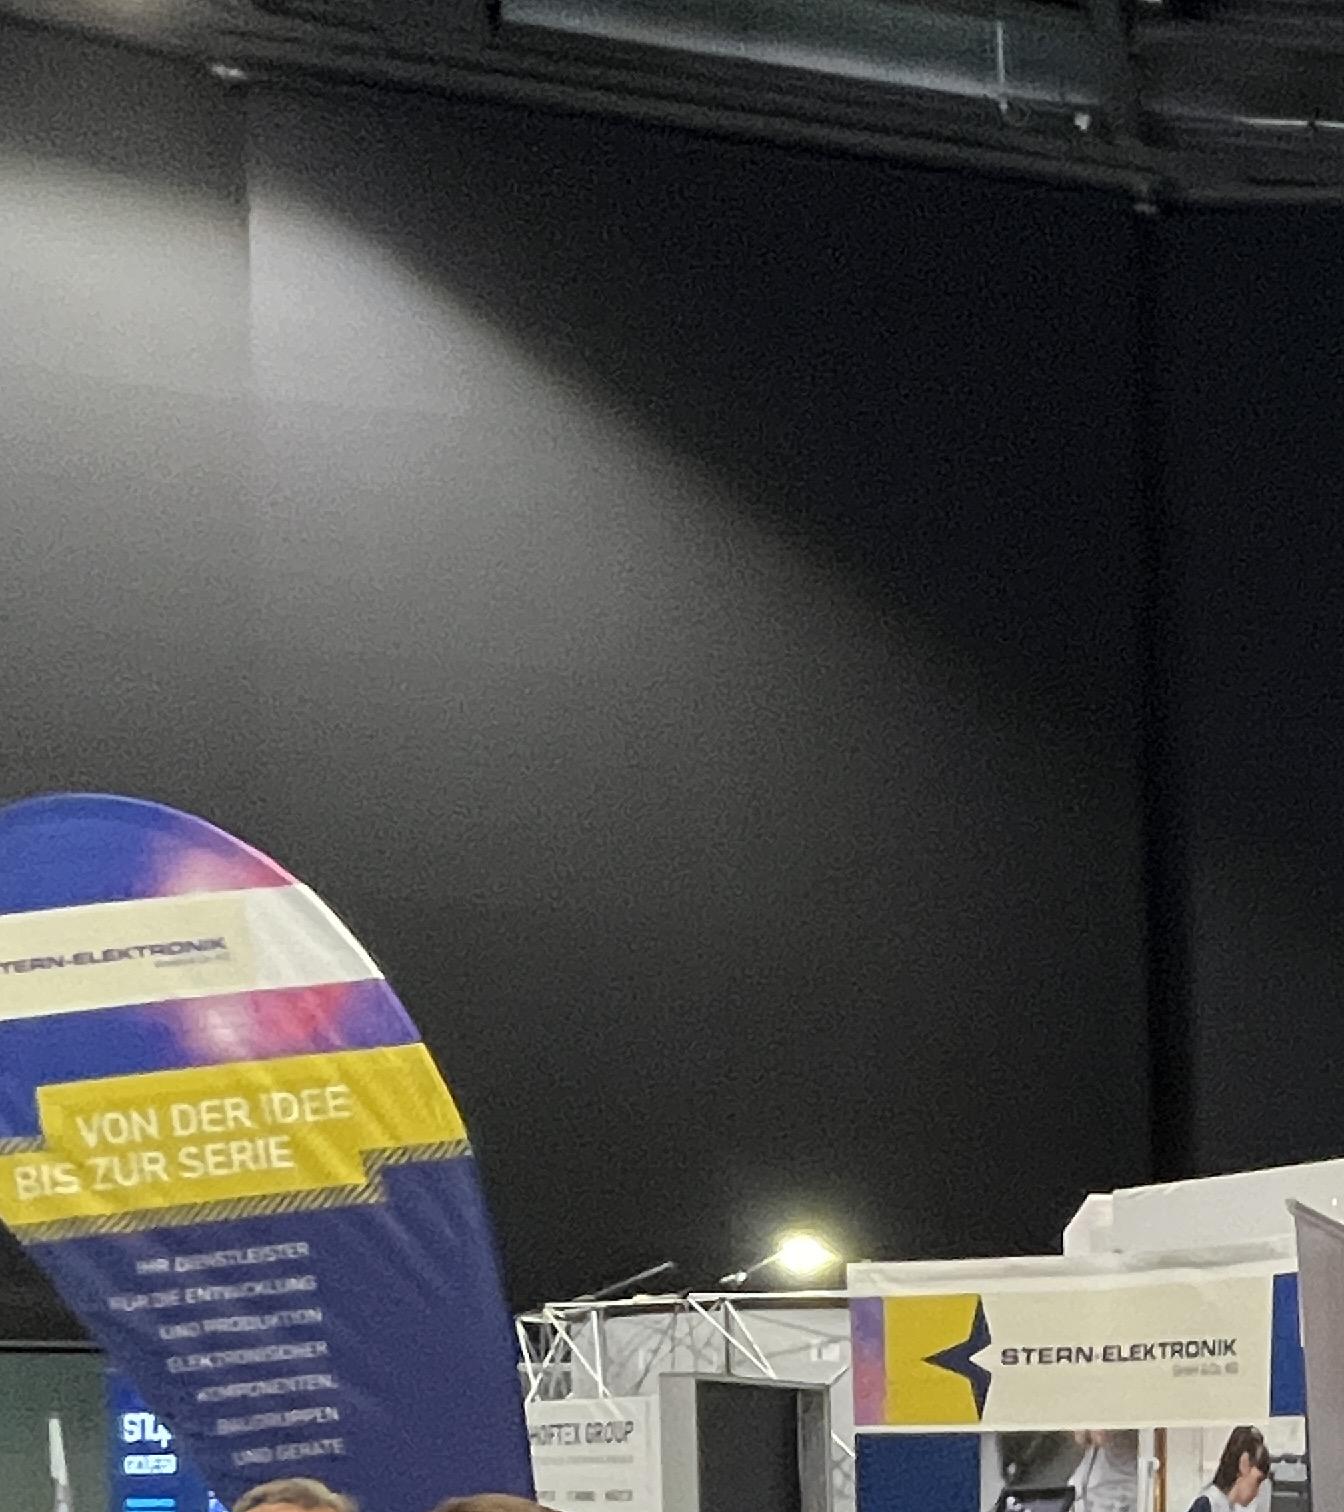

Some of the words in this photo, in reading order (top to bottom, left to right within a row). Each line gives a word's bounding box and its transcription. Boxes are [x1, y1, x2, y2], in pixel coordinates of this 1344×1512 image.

[0, 937, 227, 974] TERN-ELEKTRONIK
[76, 1108, 161, 1148] VON
[170, 1097, 257, 1137] DER
[262, 1084, 352, 1125] IDEE
[14, 1163, 81, 1200] BIS
[90, 1152, 170, 1191] ZUR
[178, 1135, 298, 1179] SERIE
[1001, 1338, 1237, 1366] STERN-ELEKTRONIK
